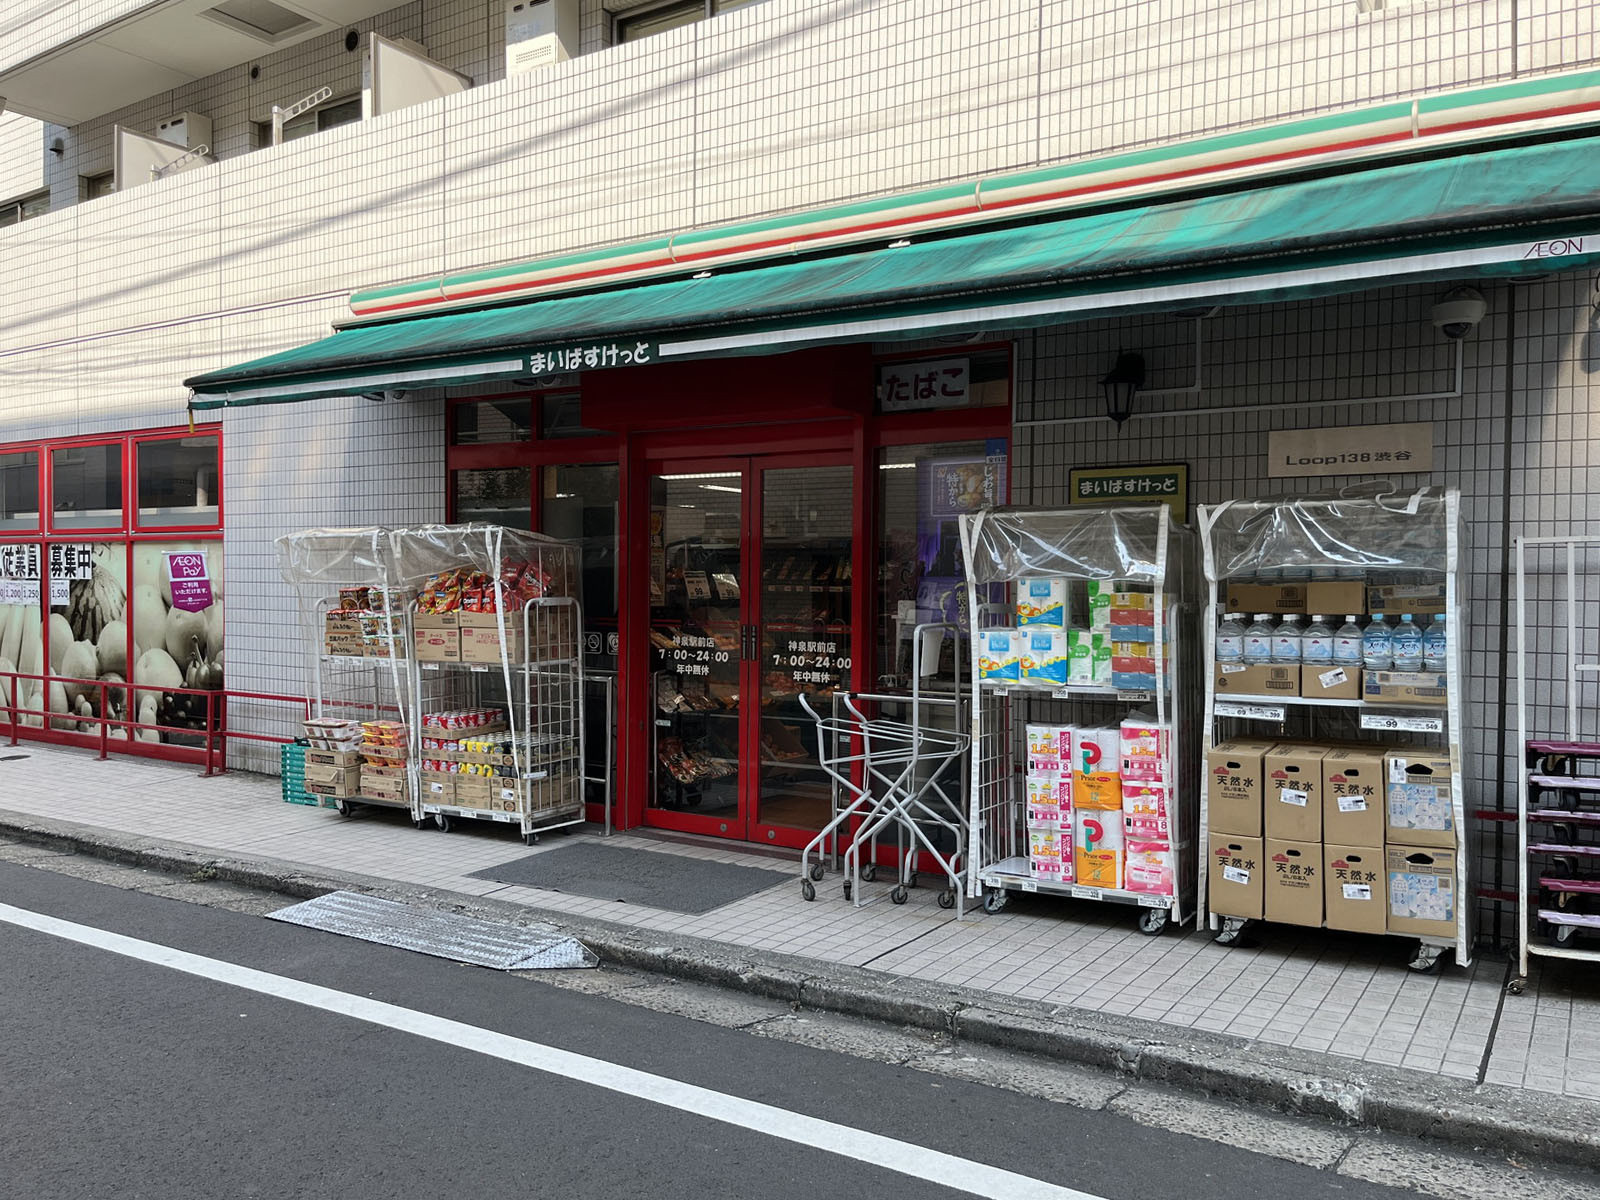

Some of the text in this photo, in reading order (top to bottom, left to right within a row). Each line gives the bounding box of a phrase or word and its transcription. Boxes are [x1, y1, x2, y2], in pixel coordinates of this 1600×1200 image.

[530, 341, 650, 374] まいばすけっと
[885, 367, 965, 402] たばこ
[1286, 450, 1412, 466] Loop138 渋谷
[1080, 478, 1176, 495] まいばすけっと
[2, 543, 91, 578] 従業員 募集中
[183, 566, 202, 576] Pay
[672, 636, 715, 648] 神泉駅前店
[788, 640, 836, 653] 神泉駅前店
[676, 664, 710, 676] 年中無休
[793, 670, 831, 683] 年中無休
[1217, 775, 1254, 788] 天然水
[1275, 780, 1314, 792] 天然水
[1334, 783, 1374, 796] 天然水
[1218, 856, 1256, 870] 天然水
[1276, 862, 1315, 876] 天然水
[1336, 868, 1376, 882] 天然水
